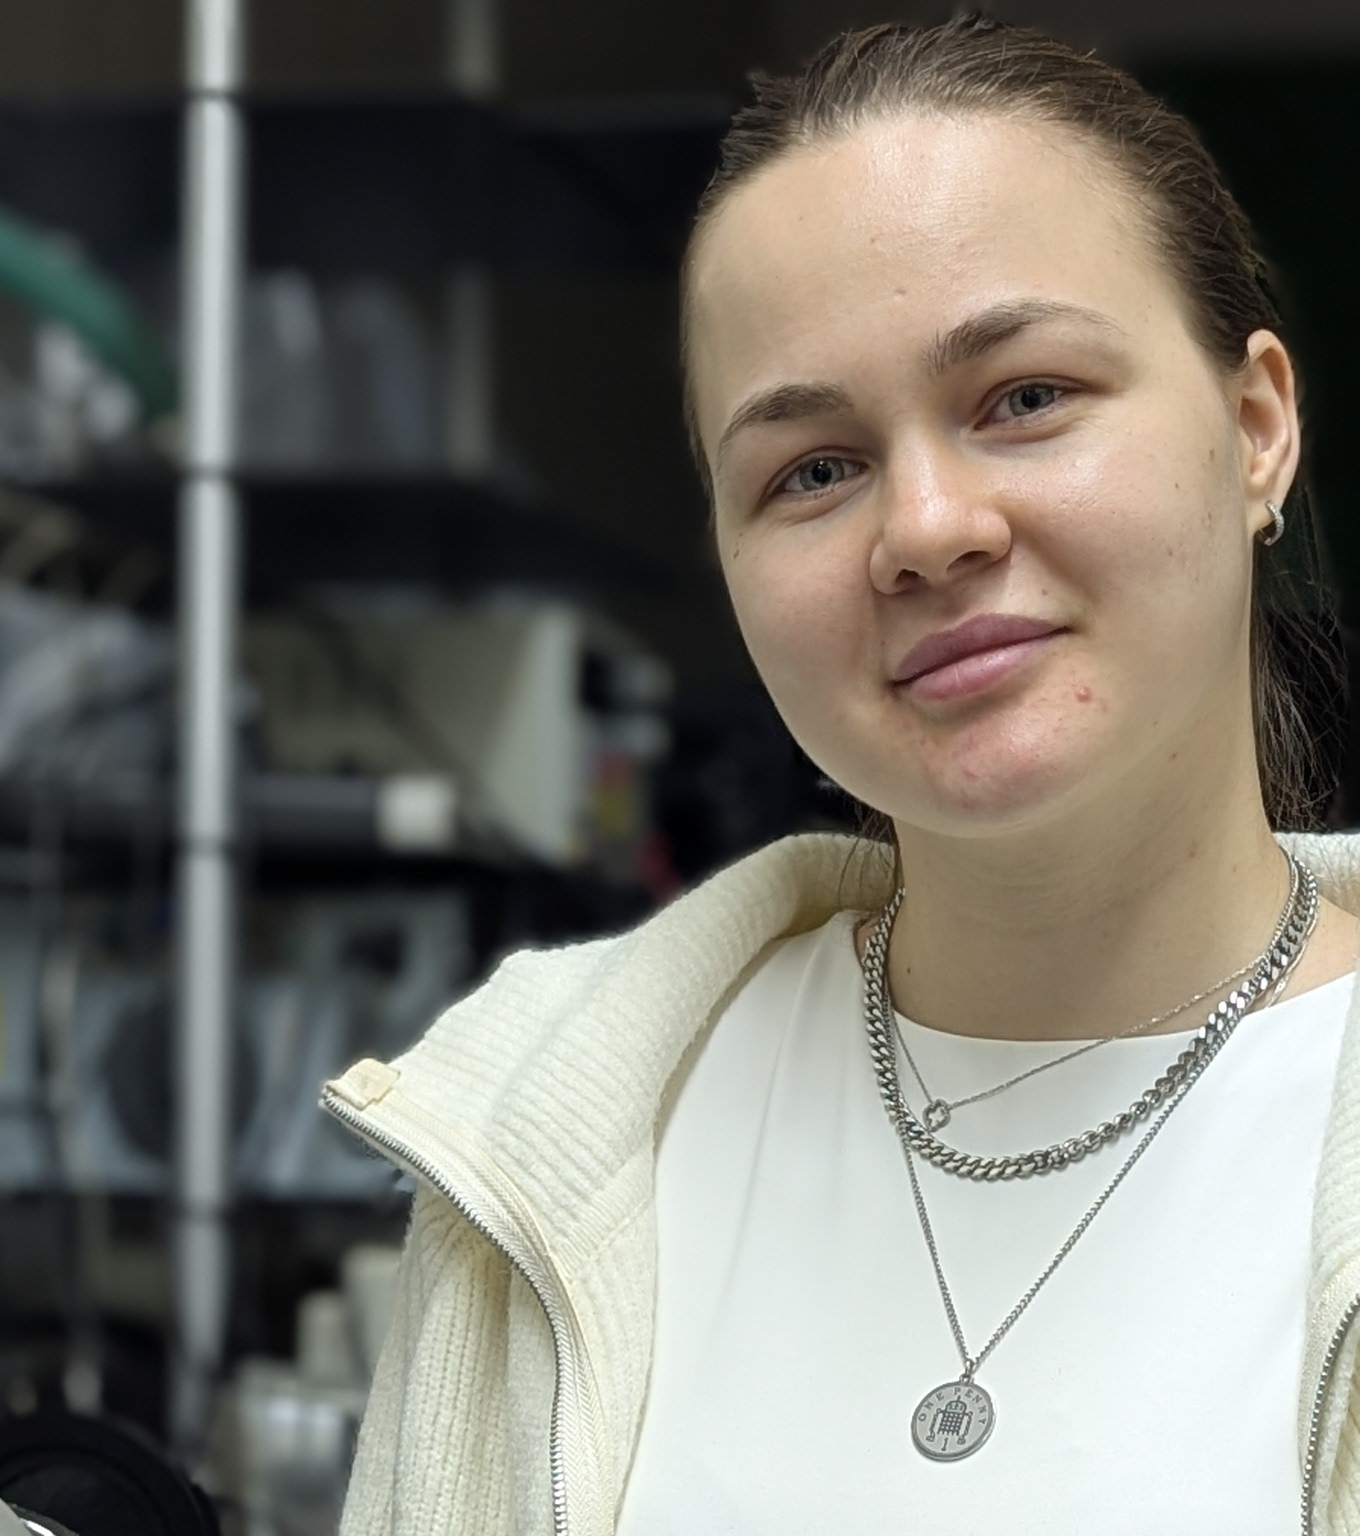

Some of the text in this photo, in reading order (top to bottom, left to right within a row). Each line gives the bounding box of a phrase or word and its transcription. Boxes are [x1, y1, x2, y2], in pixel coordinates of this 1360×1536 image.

[918, 1387, 987, 1425] ONE PENNY
[941, 1437, 948, 1451] 1
